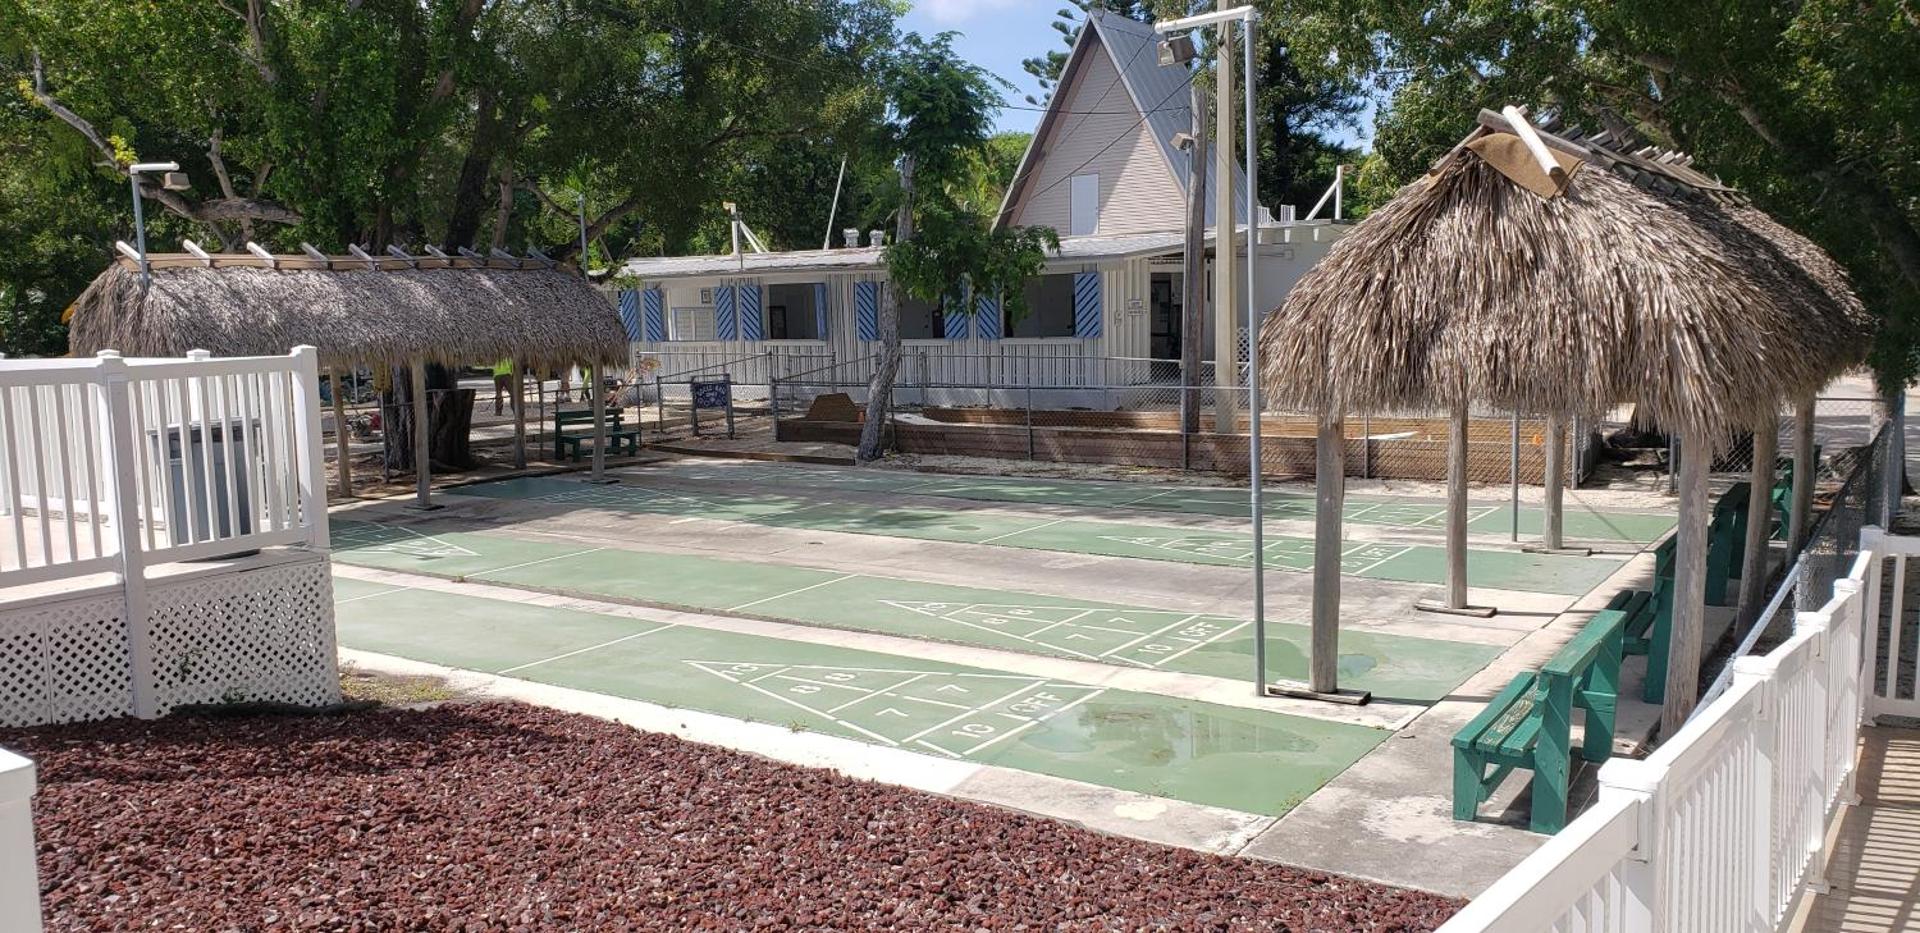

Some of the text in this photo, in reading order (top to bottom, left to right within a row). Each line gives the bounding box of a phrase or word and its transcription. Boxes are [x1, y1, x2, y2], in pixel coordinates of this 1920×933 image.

[1137, 644, 1173, 654] 10
[824, 672, 856, 681] 8
[789, 685, 822, 694] 8
[936, 684, 969, 693] 7
[875, 707, 909, 717] 7
[951, 691, 1062, 738] 10 OFF
